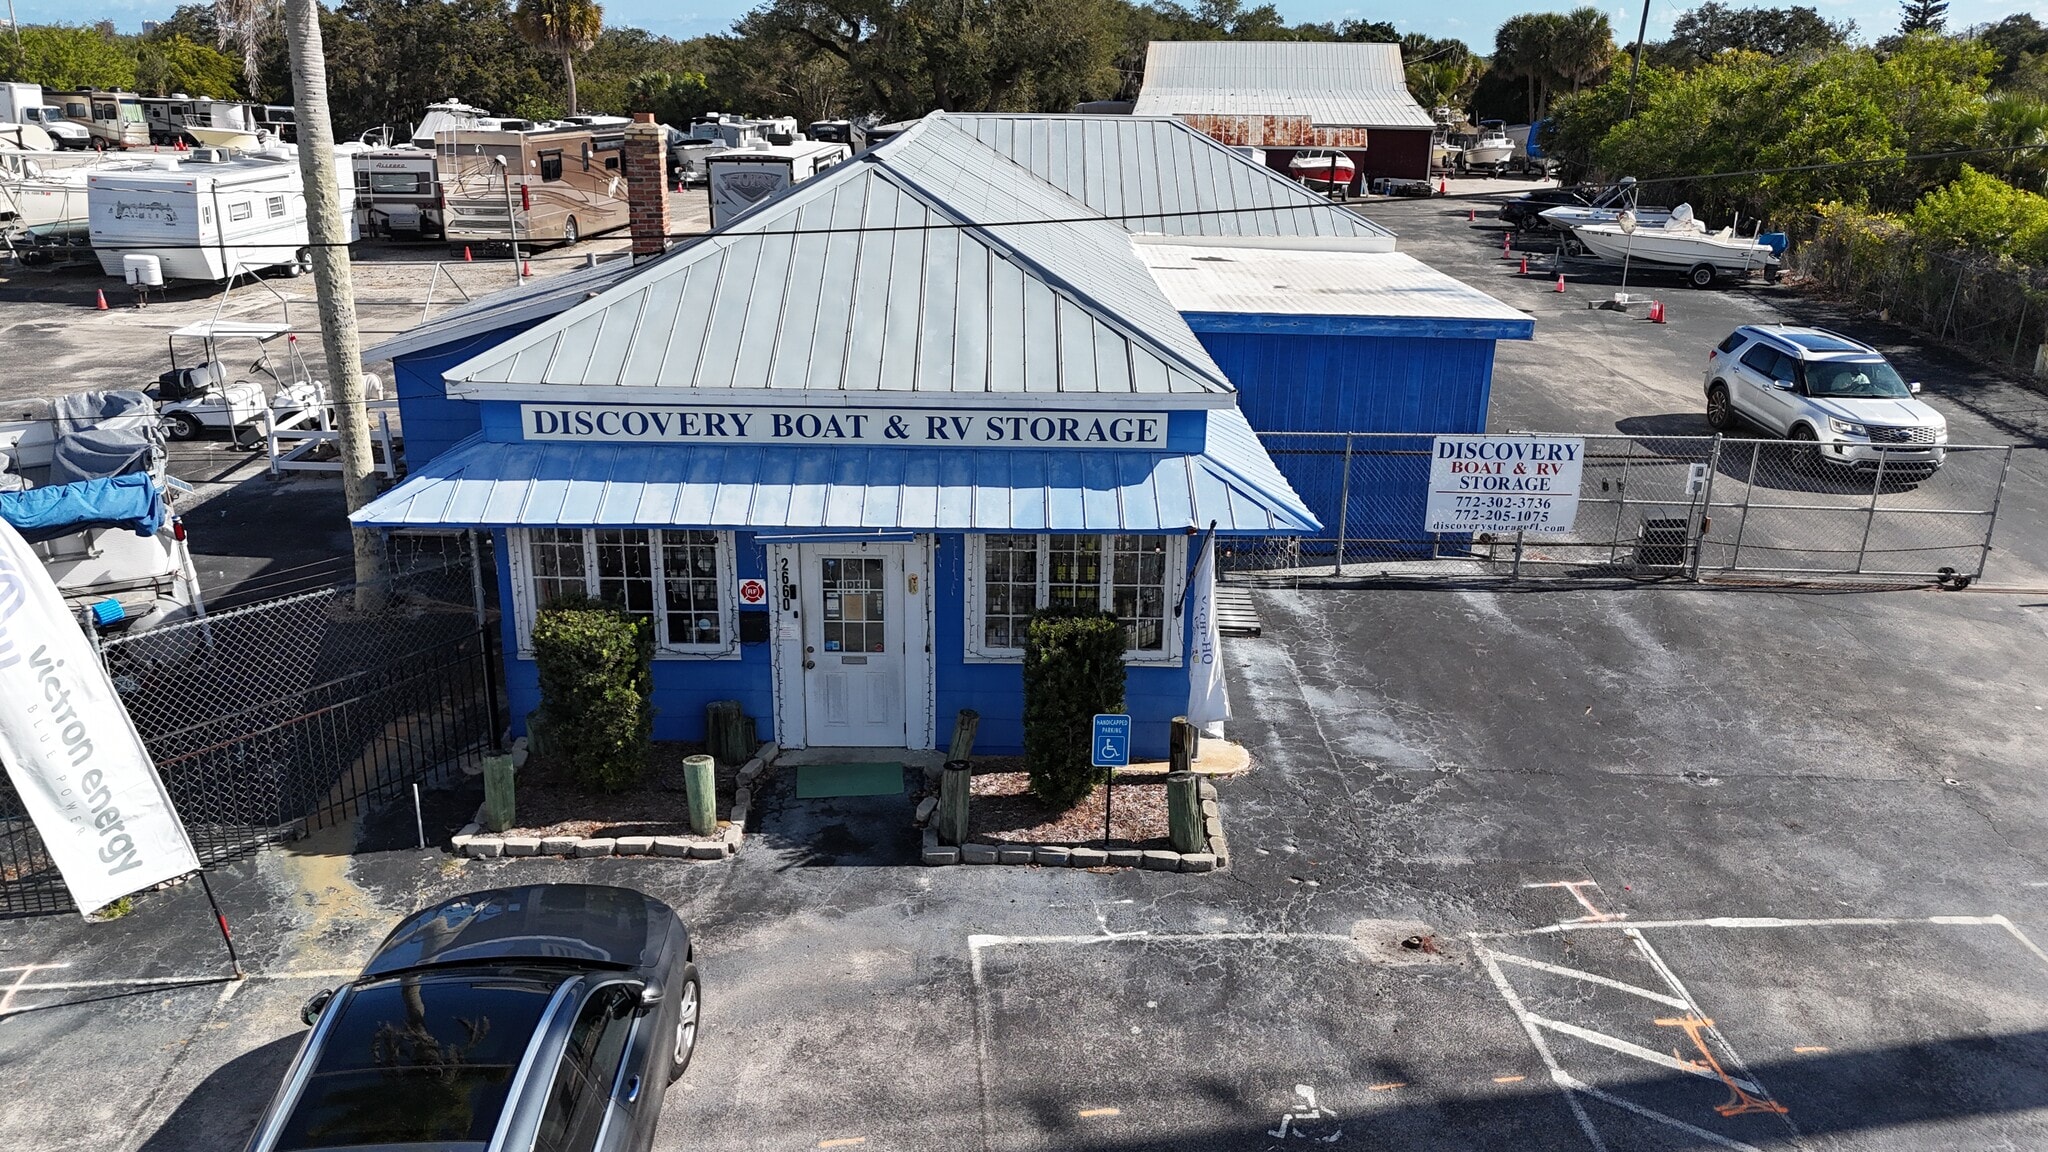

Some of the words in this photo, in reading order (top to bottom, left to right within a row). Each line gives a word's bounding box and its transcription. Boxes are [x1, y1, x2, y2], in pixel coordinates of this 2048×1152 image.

[725, 174, 778, 190] FURY
[533, 409, 754, 438] DISCOVERY
[770, 412, 869, 439] BOAT
[884, 414, 911, 440] &
[925, 415, 975, 441] RV
[986, 416, 1159, 443] STORAGE
[1438, 442, 1580, 461] DISCOVERY
[1451, 461, 1506, 475] BOAT
[1513, 462, 1527, 475] &
[1537, 462, 1564, 476] RV
[1459, 476, 1551, 492] STORAGE
[1455, 496, 1551, 509] 772-302-3736
[1454, 510, 1549, 522] 772-205-1075
[1433, 520, 1566, 533] discoverystoragefl.com
[747, 587, 757, 595] RF
[781, 558, 790, 611] 2660
[28, 644, 94, 768] victron
[81, 768, 143, 876] energy
[27, 704, 56, 760] BLUE
[56, 774, 86, 837] POWER
